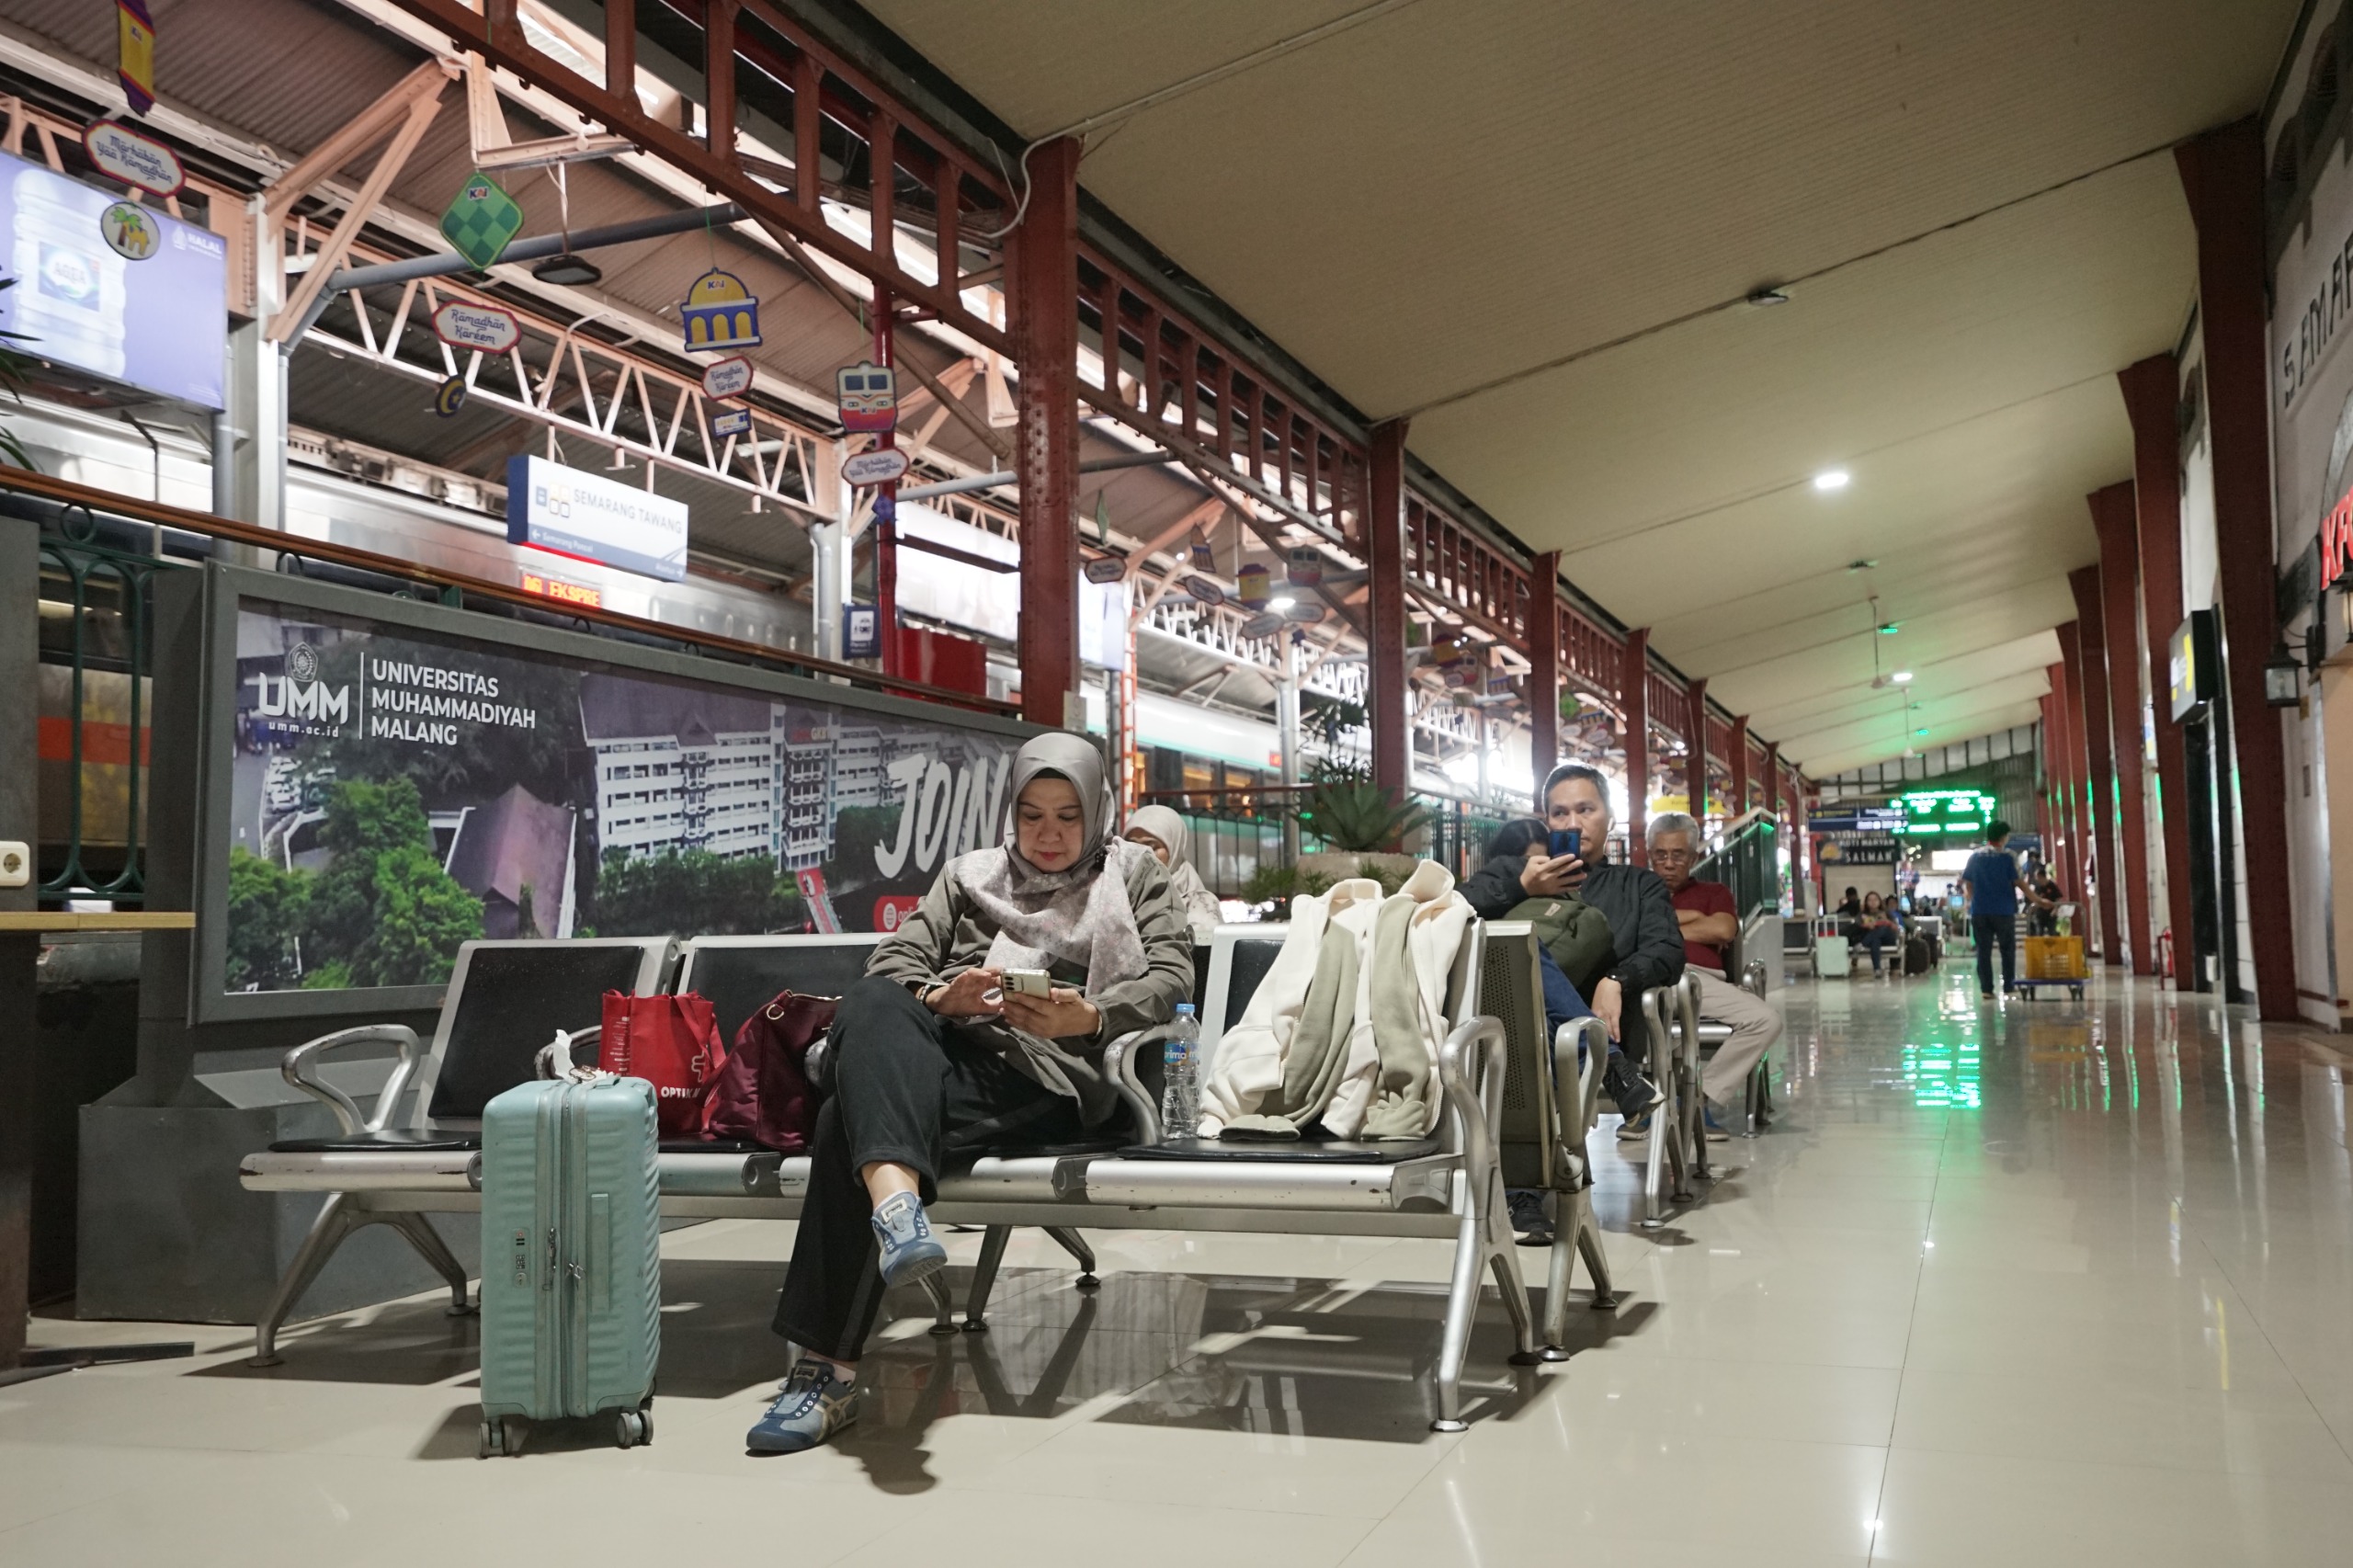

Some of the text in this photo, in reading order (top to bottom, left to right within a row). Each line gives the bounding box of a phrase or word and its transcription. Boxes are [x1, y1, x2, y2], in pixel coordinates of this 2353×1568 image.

[574, 488, 683, 535] SEMARANG TAWANG
[259, 672, 349, 724] UMM
[372, 658, 499, 698] UNIVERSITAS
[268, 721, 339, 737] umm.ac.id
[371, 687, 536, 729] MUHAMMADIYAH
[371, 715, 458, 745] MALANG
[874, 752, 1010, 879] JOIN
